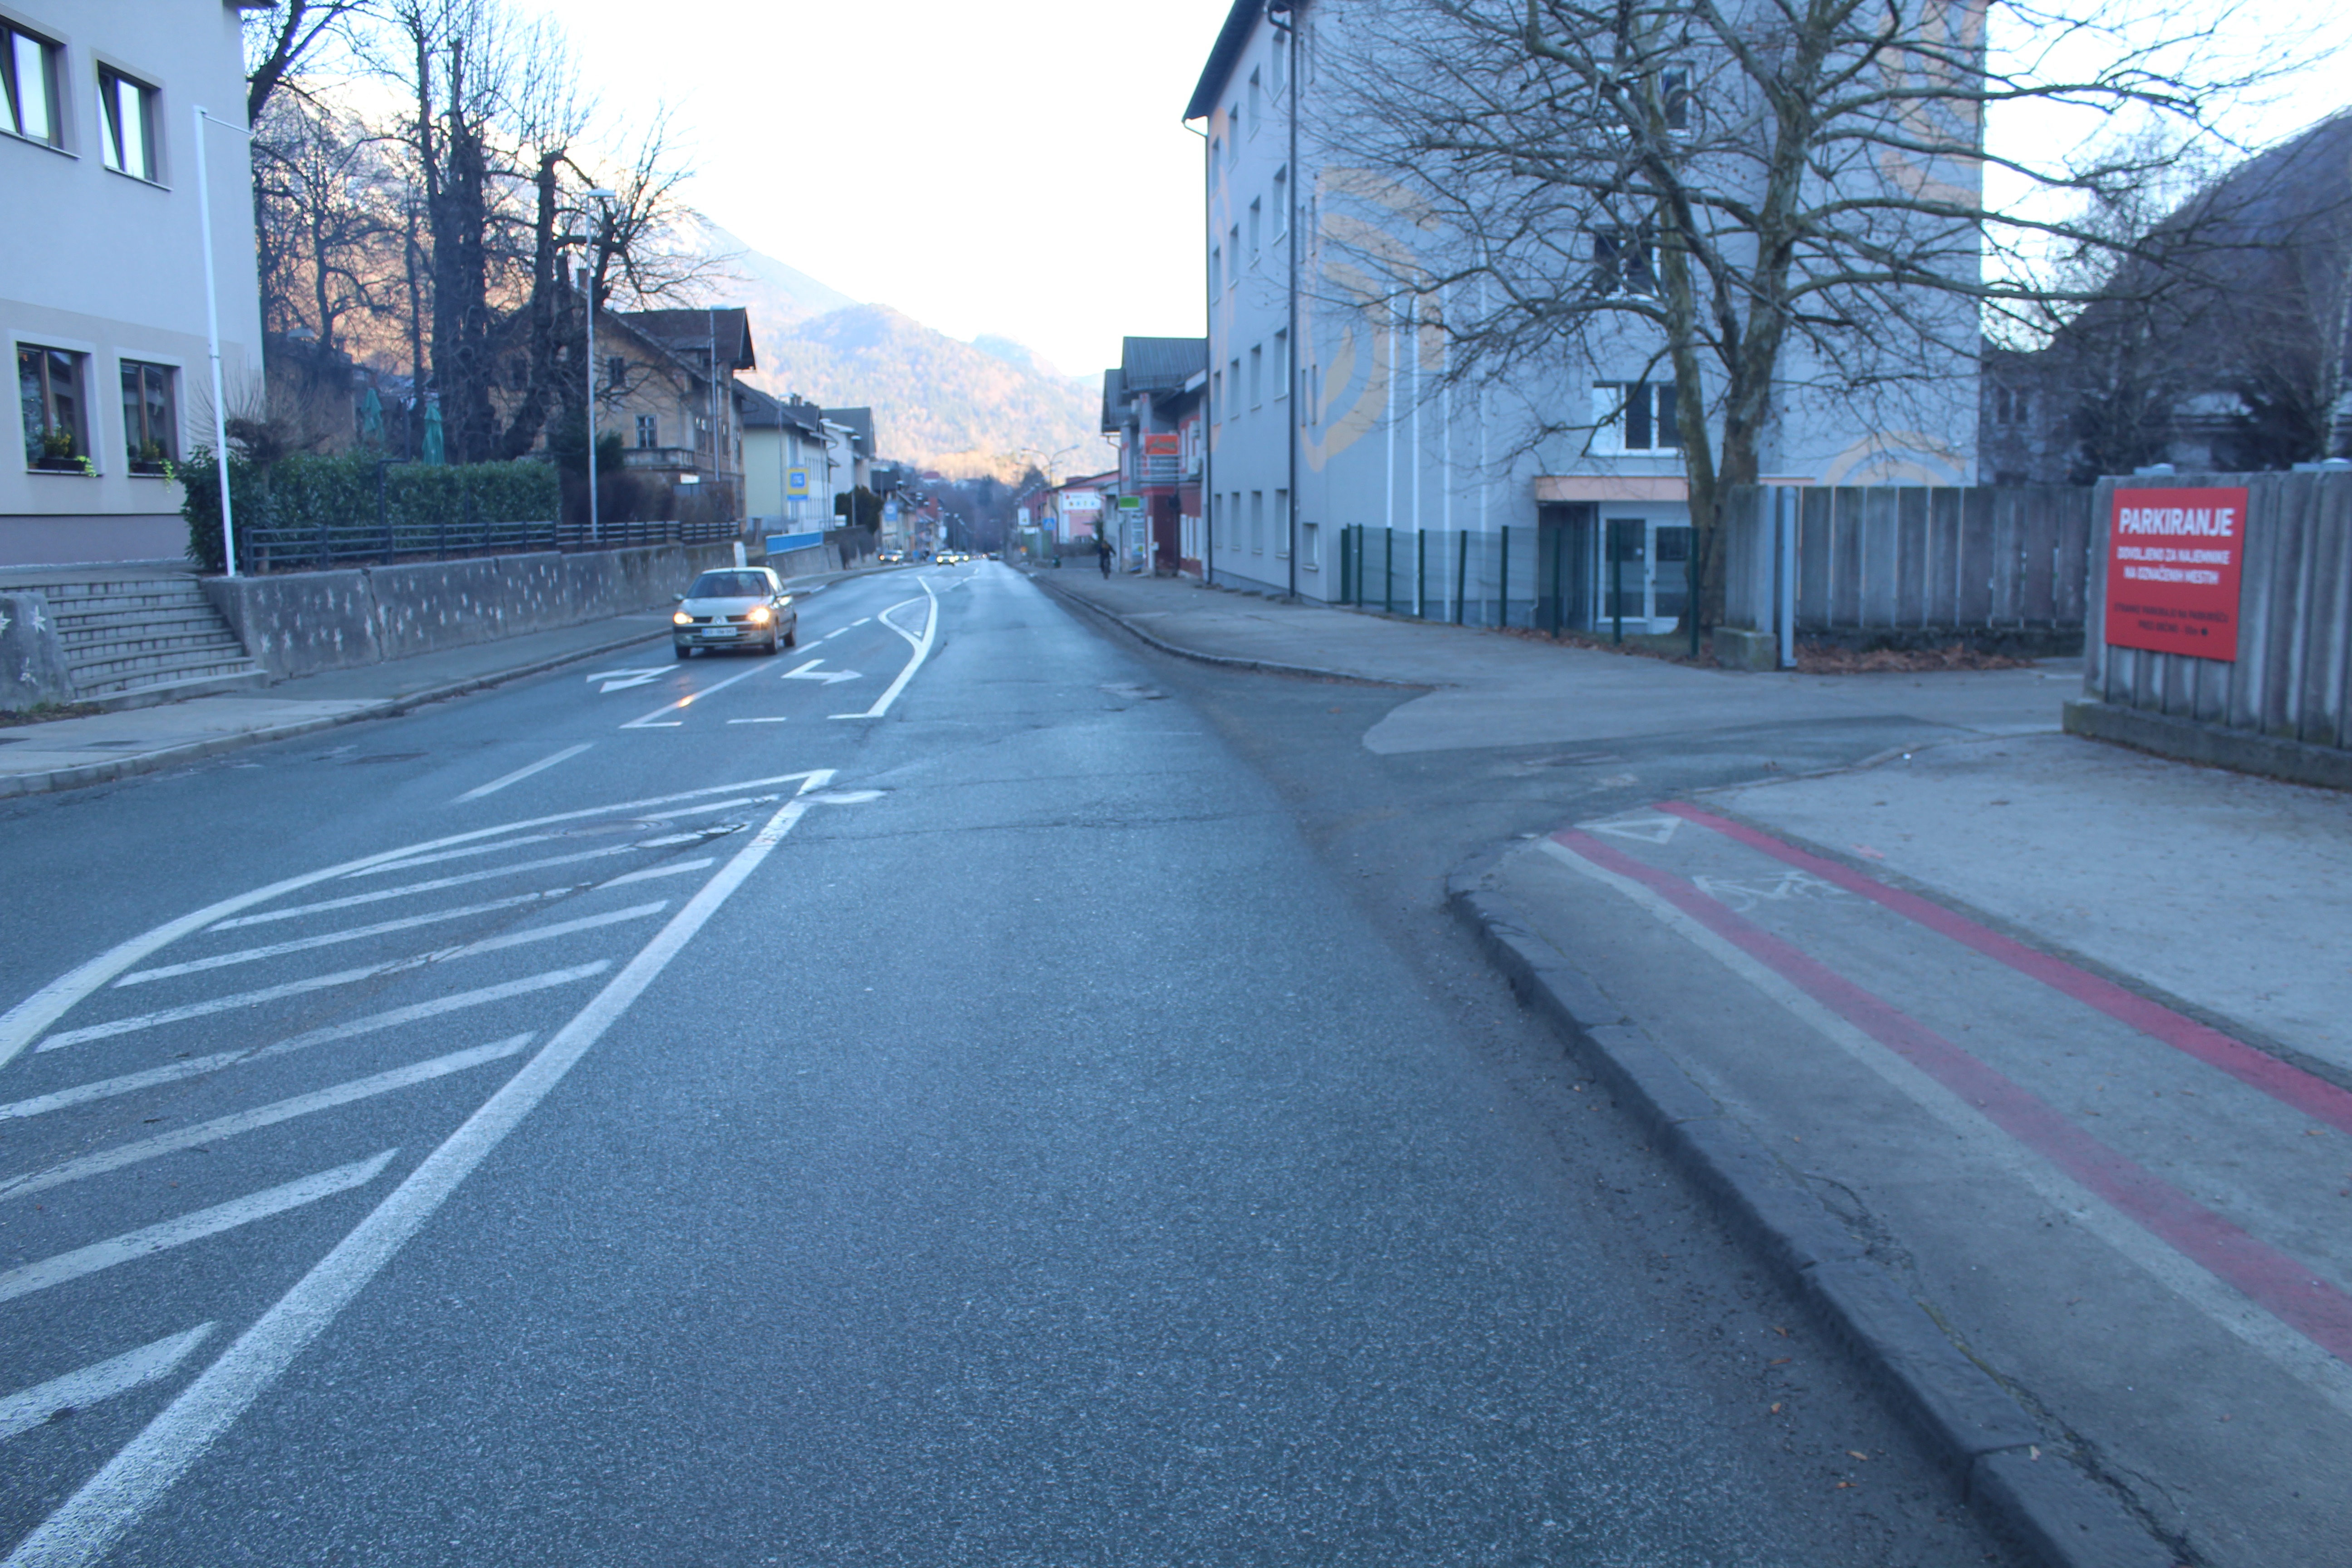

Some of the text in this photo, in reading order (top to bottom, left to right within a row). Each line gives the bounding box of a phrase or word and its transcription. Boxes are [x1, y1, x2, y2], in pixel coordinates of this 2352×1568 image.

[2119, 508, 2234, 537] PARKIRANJE
[2117, 546, 2164, 561] DOVOLJENO
[2165, 548, 2176, 562] ZA
[2123, 566, 2136, 579] NA
